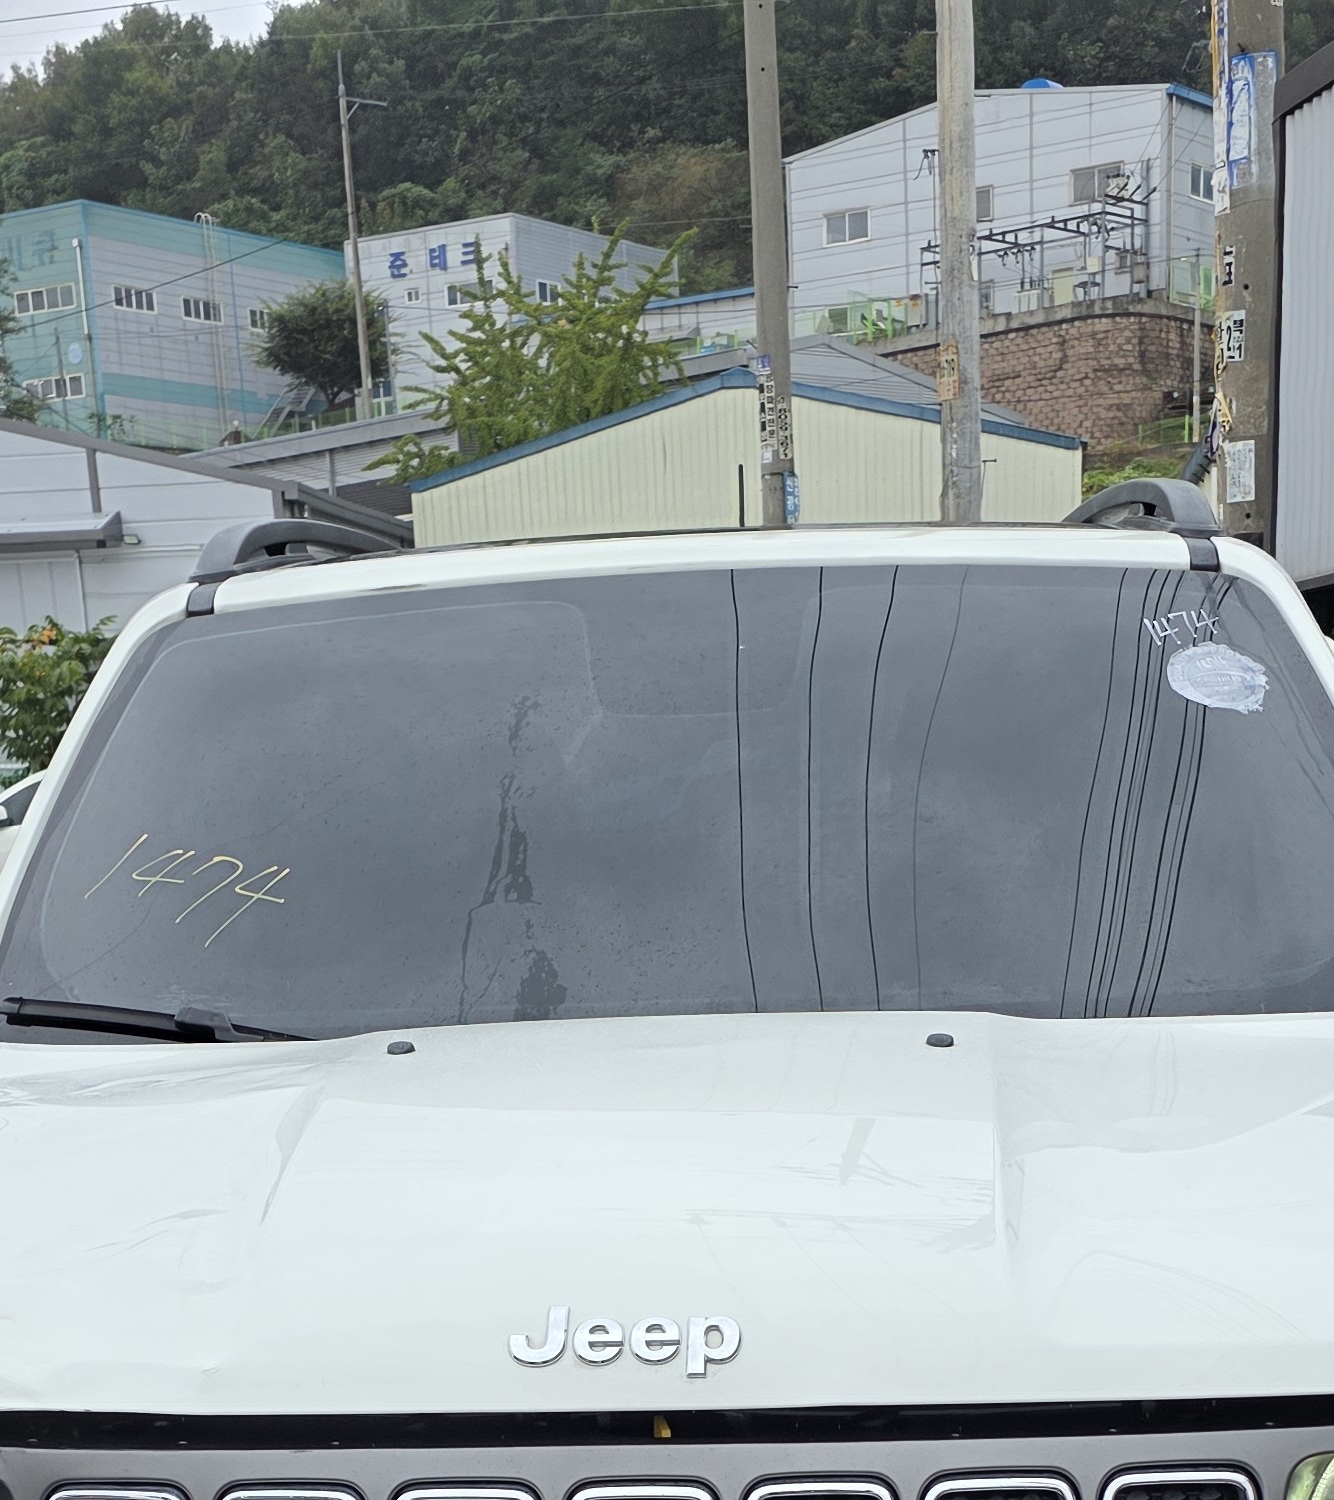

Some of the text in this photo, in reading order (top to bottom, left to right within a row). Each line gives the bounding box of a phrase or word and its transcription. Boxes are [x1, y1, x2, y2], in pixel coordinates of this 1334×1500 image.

[1143, 608, 1219, 646] 1474
[84, 833, 290, 948] 1474
[507, 1305, 742, 1379] Jeep
